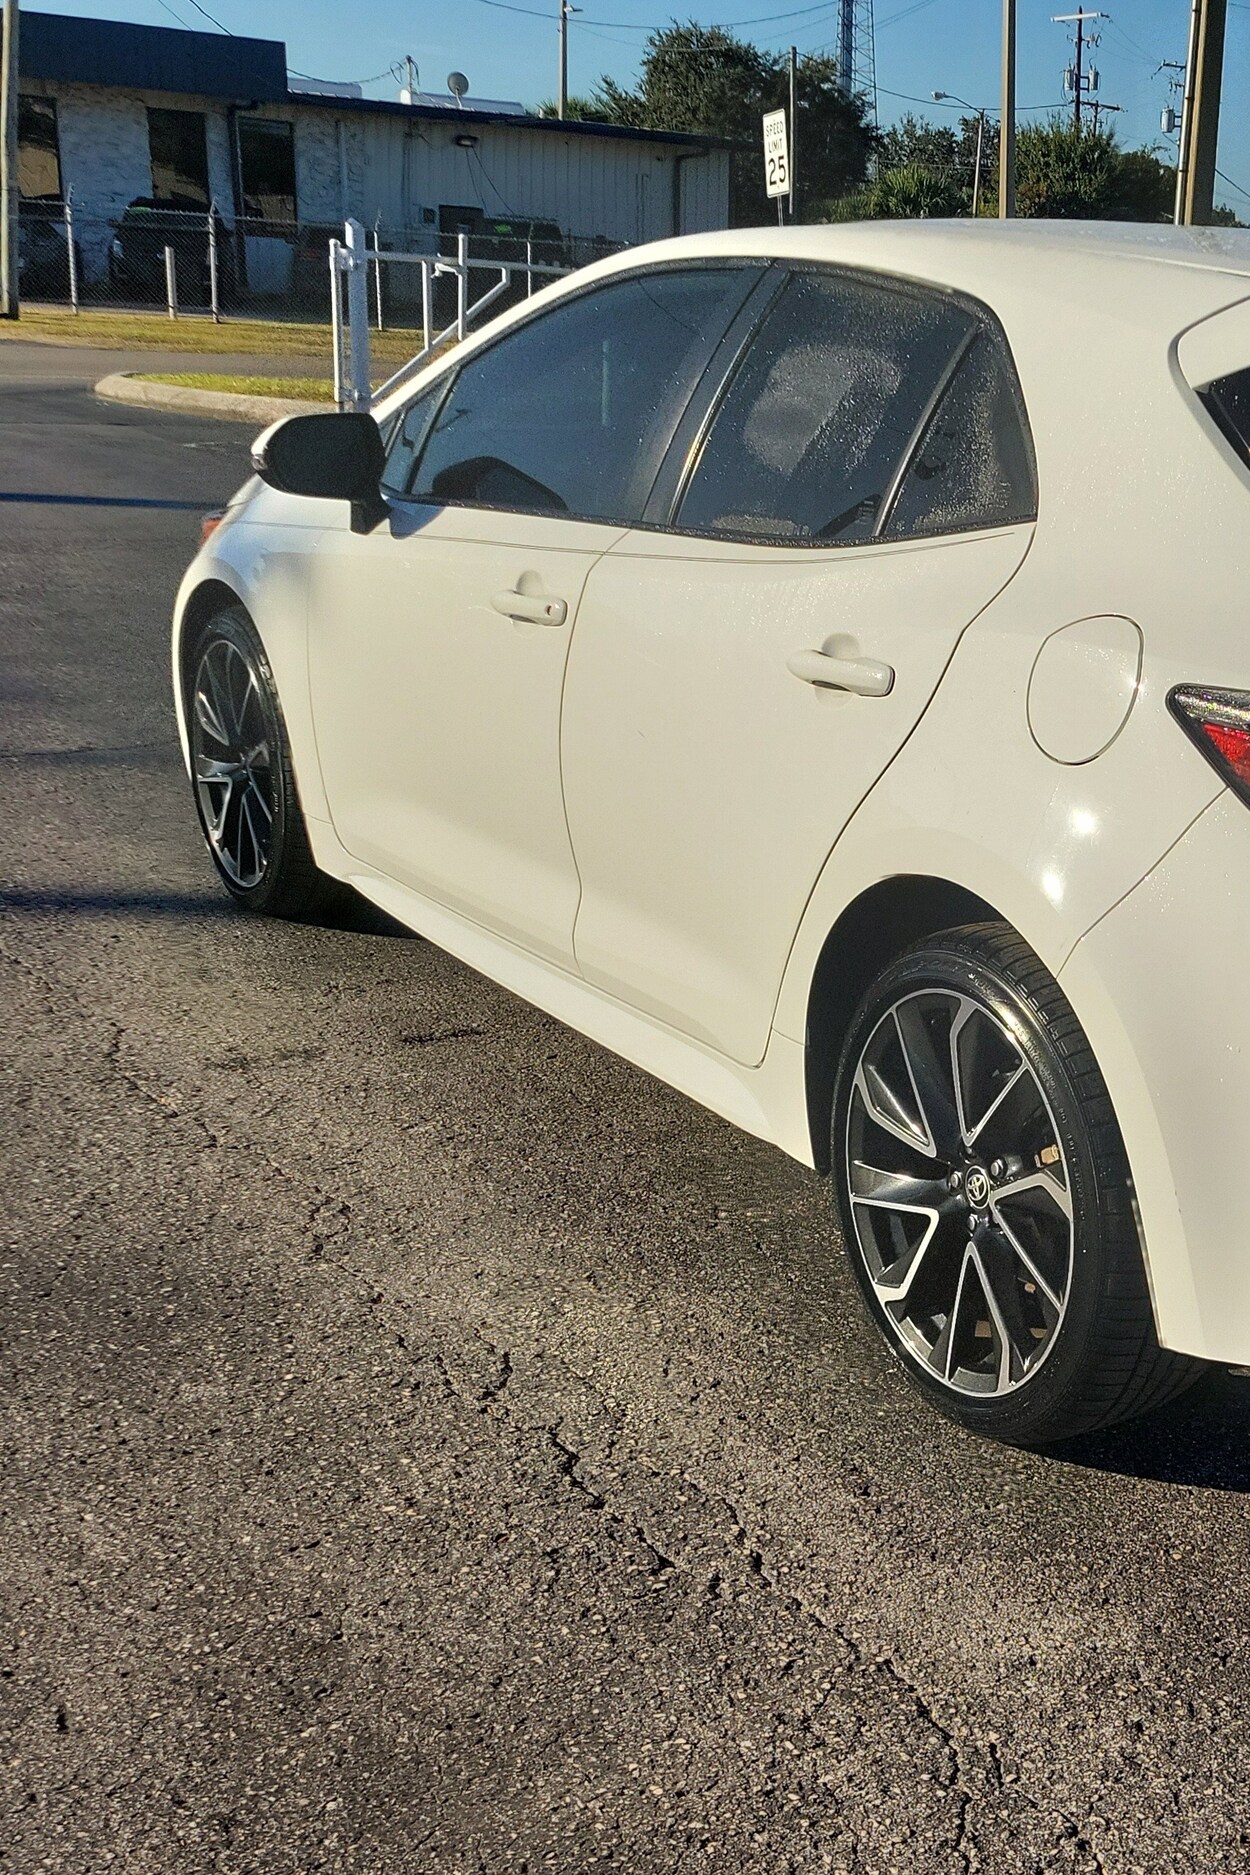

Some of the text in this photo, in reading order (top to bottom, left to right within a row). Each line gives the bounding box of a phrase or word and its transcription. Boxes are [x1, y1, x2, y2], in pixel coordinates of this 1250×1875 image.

[766, 121, 784, 137] SPEED
[768, 138, 782, 153] LIMIT
[768, 155, 786, 186] 25
